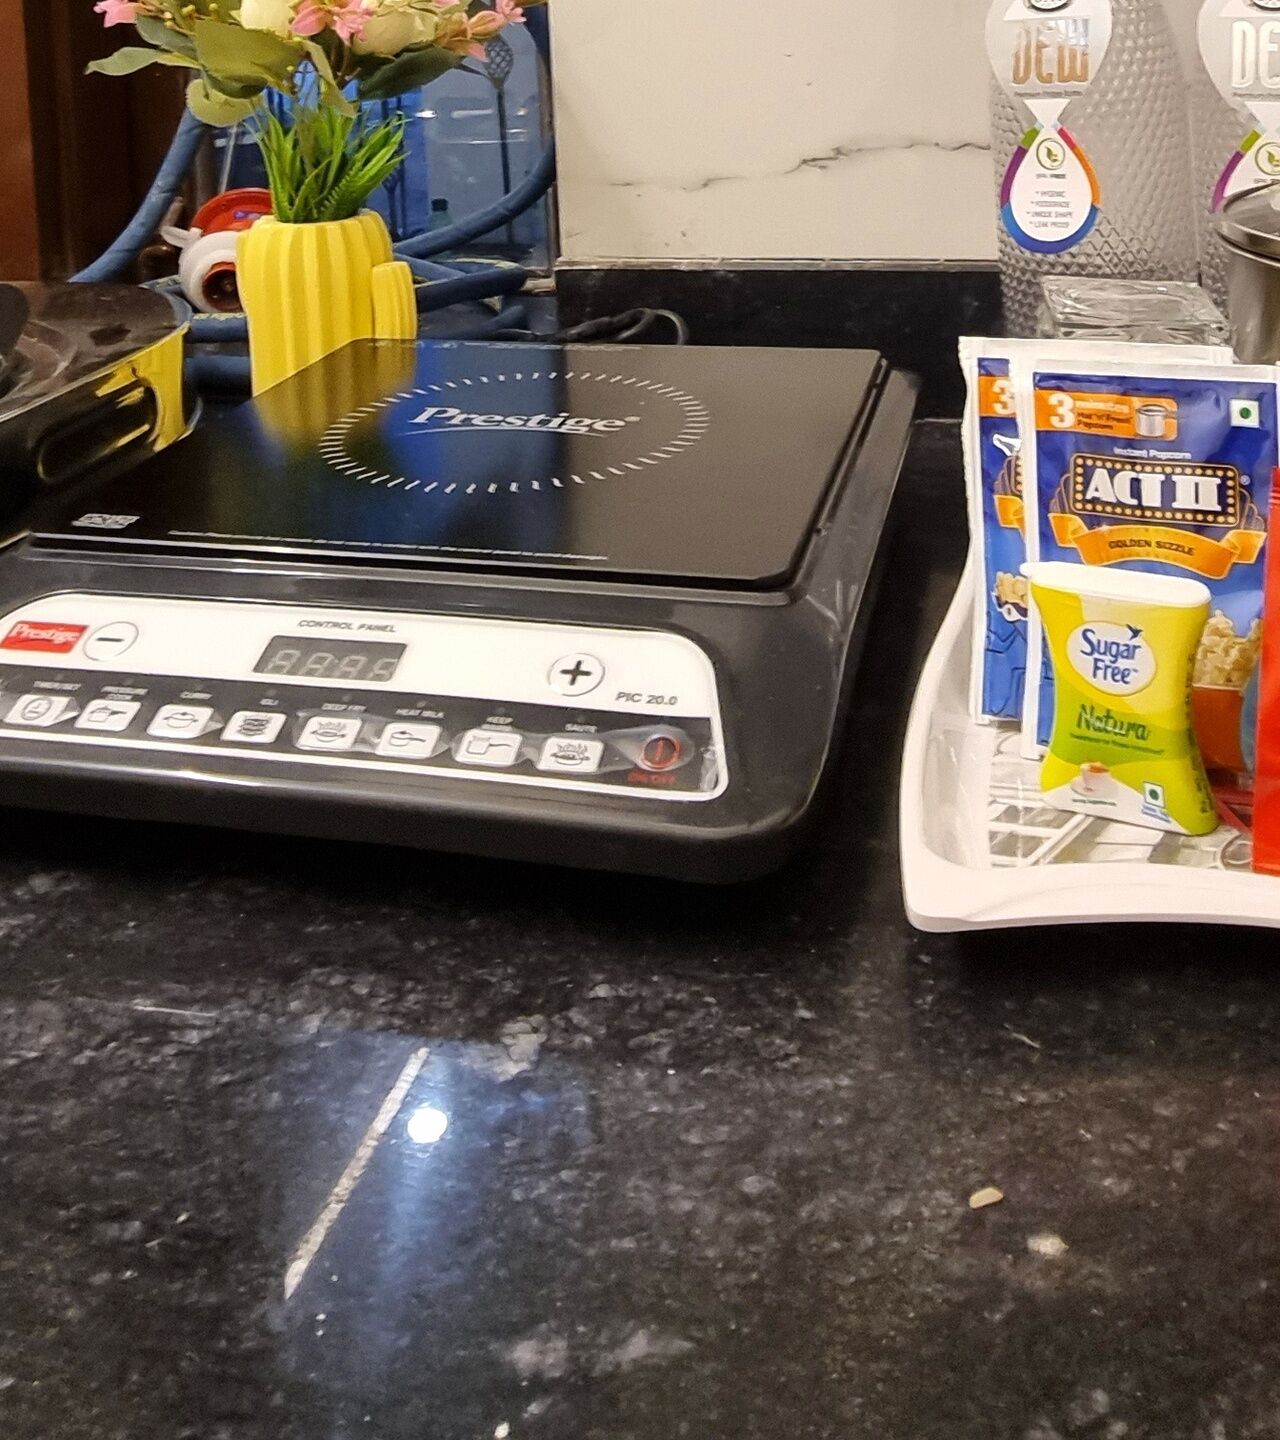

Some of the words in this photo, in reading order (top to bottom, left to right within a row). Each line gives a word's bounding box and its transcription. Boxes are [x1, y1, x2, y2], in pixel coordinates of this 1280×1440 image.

[992, 379, 1014, 415] 3
[1048, 391, 1076, 428] 3
[408, 406, 627, 434] Prestige
[1085, 467, 1166, 508] ACT
[1172, 474, 1222, 512] II
[1108, 539, 1153, 550] GOLDEN
[297, 619, 354, 631] CONTROL
[356, 622, 397, 633] PANEL
[1080, 628, 1142, 665] Sugar
[1092, 658, 1132, 685] Free
[615, 691, 643, 704] PIC
[645, 693, 678, 707] 20.0
[1075, 703, 1150, 742] Natura
